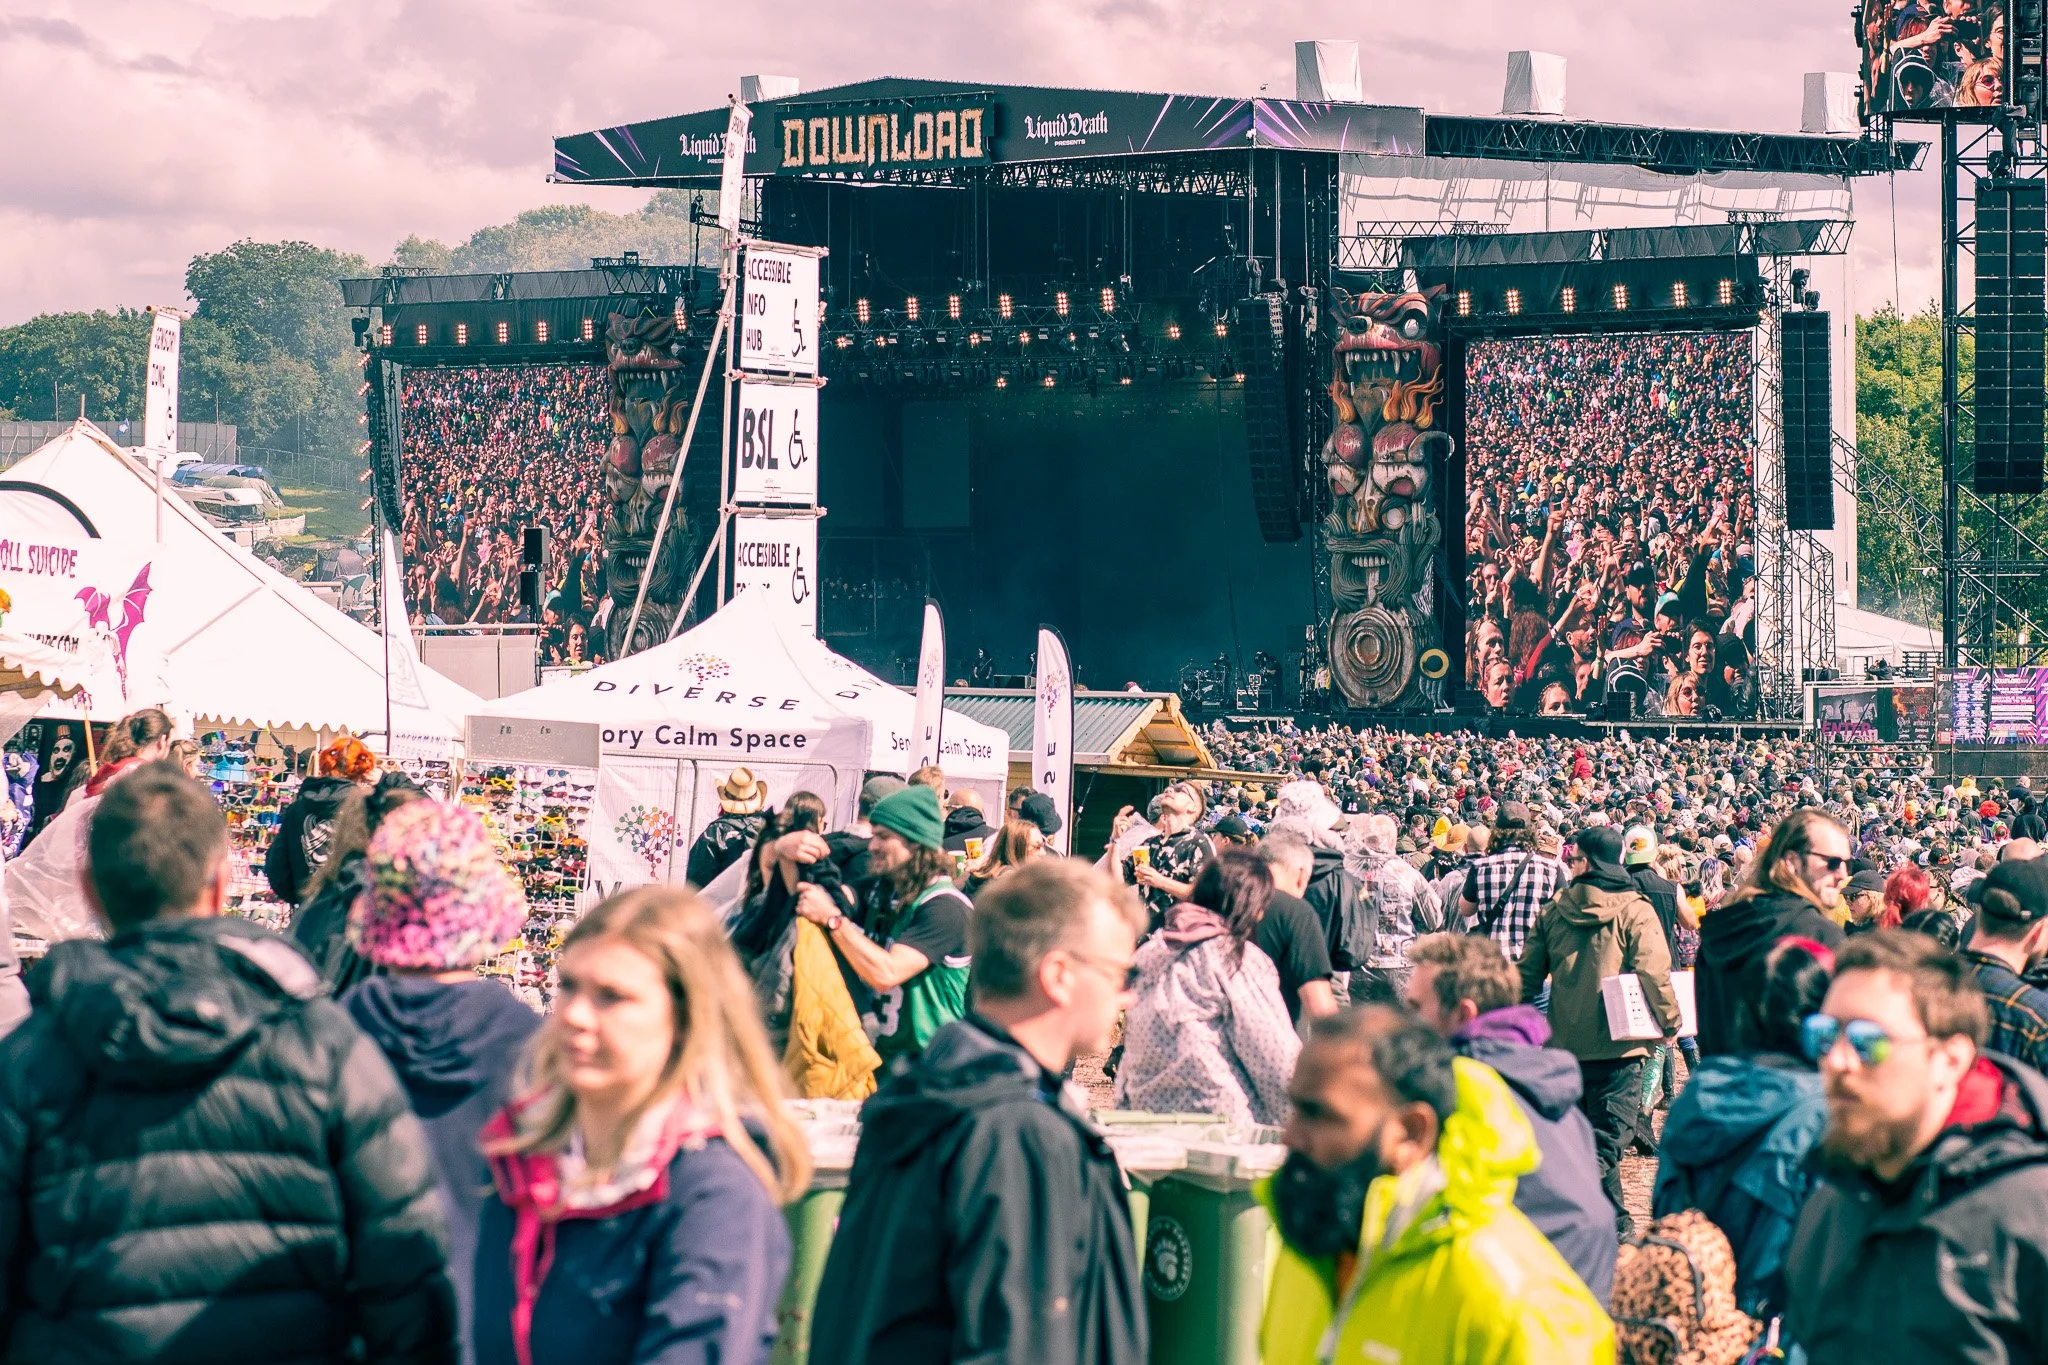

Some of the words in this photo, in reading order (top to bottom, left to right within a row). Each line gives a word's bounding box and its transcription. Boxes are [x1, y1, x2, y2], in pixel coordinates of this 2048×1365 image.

[782, 108, 984, 168] DOWNLOAD
[1024, 114, 1068, 144] Liquid
[1067, 110, 1108, 137] Death
[680, 132, 720, 162] Liquid
[1054, 139, 1086, 147] PRESENTS
[748, 258, 792, 284] ACCESSIBLE
[747, 293, 766, 316] INFO
[746, 329, 763, 351] HUB
[742, 408, 779, 470] BSL
[29, 545, 78, 579] SUICIDE
[593, 681, 800, 711] DIVERSE
[655, 725, 718, 747] Calm
[730, 727, 806, 753] Space
[1822, 721, 1872, 737] ENTER
[963, 738, 992, 763] Space
